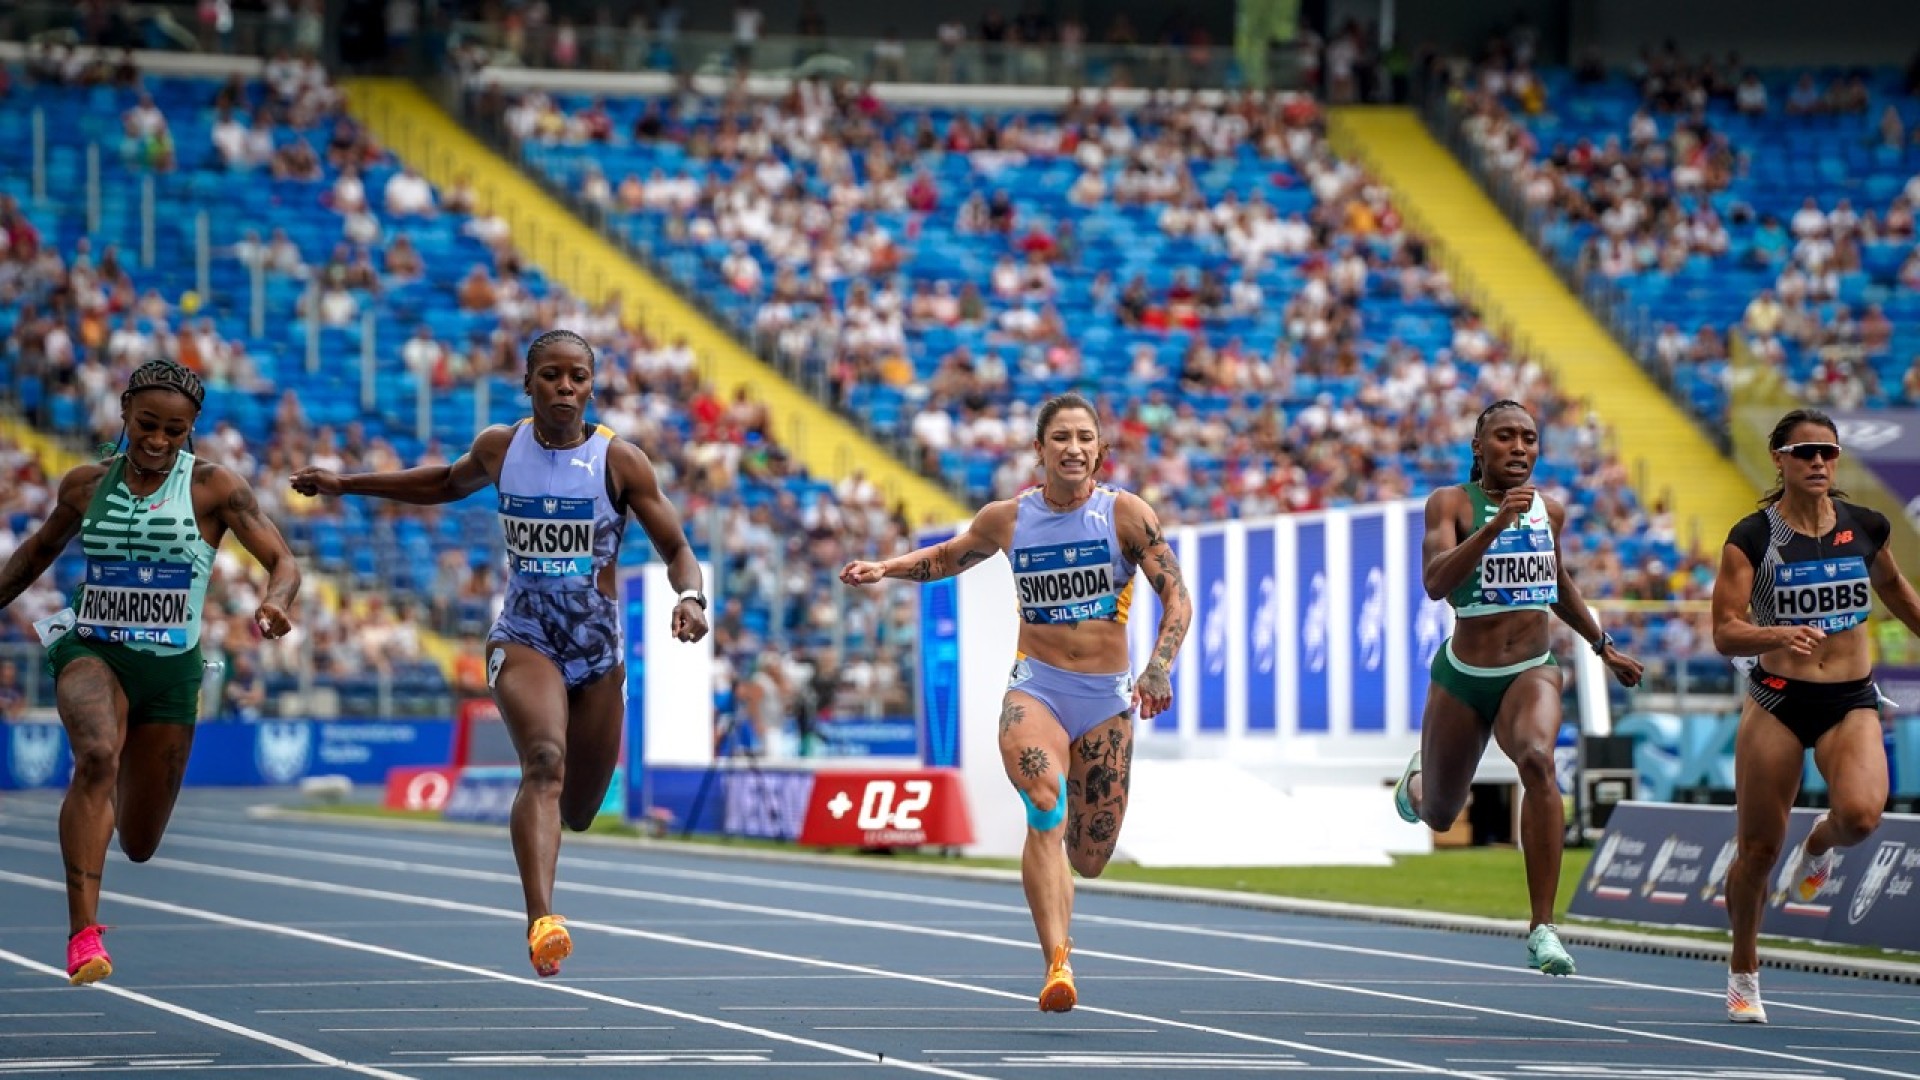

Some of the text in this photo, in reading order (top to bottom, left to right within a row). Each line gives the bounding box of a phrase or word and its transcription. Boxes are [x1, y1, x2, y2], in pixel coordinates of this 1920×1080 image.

[504, 519, 589, 552] JACKSON
[520, 559, 578, 573] SILESIA
[1020, 568, 1110, 603] SWOBODA
[1512, 589, 1556, 601] SILESIA
[84, 590, 186, 623] RICHARDSON
[1049, 601, 1102, 620] SILESIA
[1778, 583, 1868, 614] HOBBS
[1809, 615, 1858, 630] SILESIA
